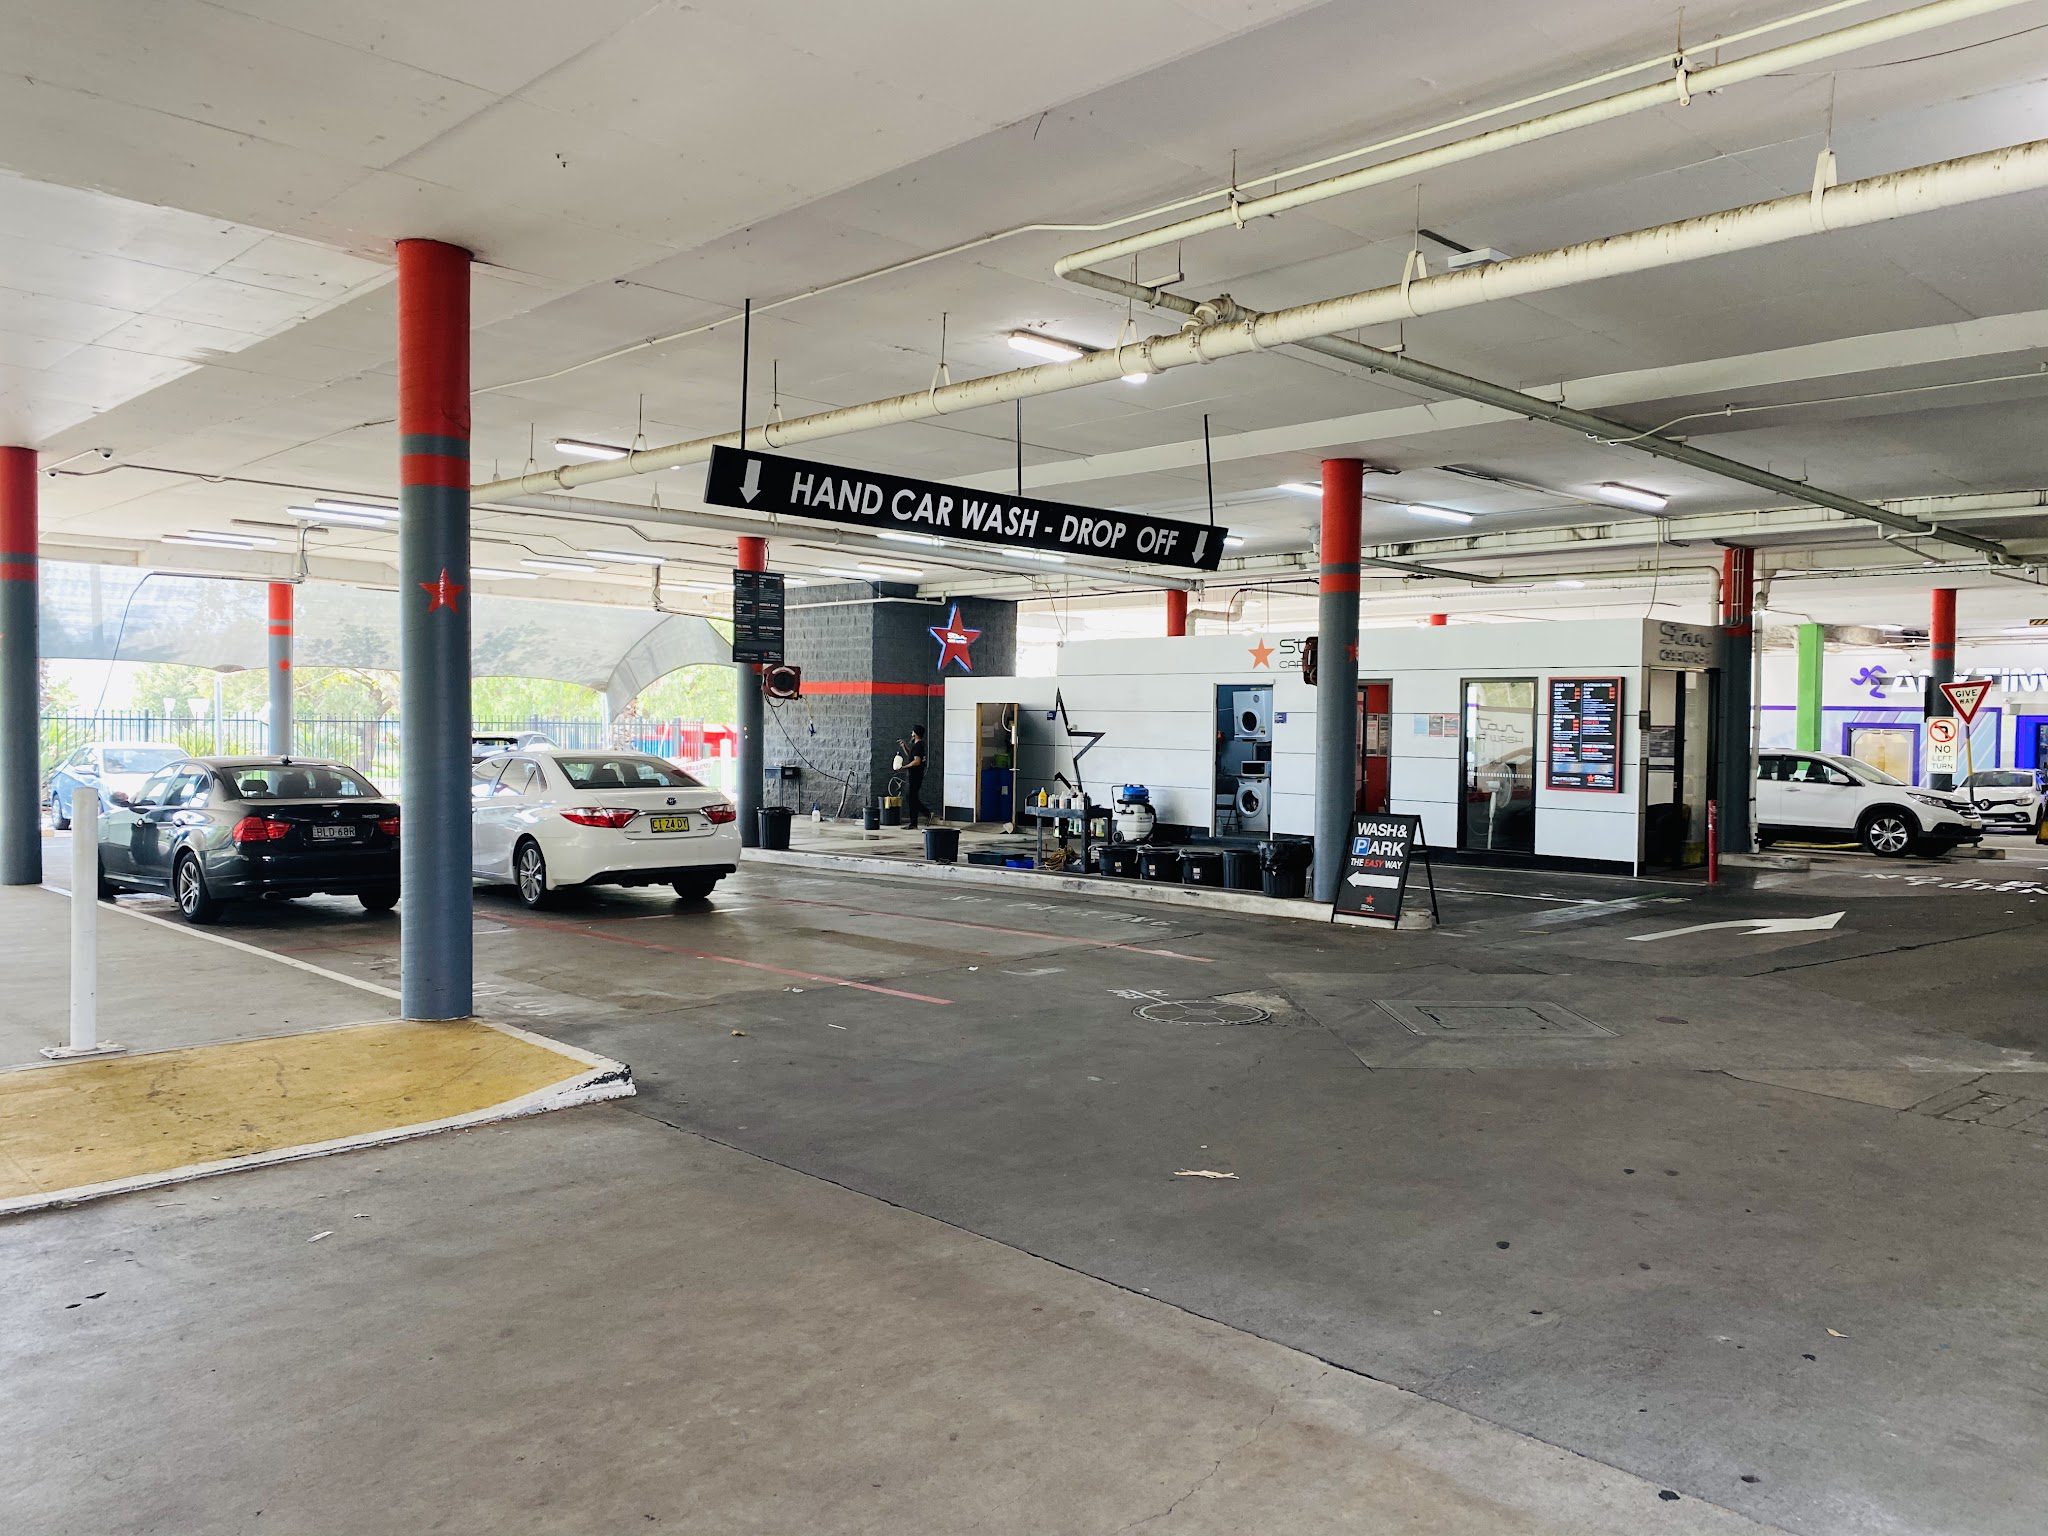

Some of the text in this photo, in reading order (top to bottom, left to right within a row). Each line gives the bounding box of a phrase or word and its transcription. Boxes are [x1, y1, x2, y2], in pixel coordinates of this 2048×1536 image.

[790, 471, 883, 516] HAND
[891, 489, 953, 528] CAR
[961, 499, 1038, 538] WASH
[1059, 515, 1127, 550] DROP
[1136, 526, 1180, 557] OFF
[1956, 688, 1978, 698] GIVE
[1934, 745, 1951, 754] NO
[1352, 837, 1406, 857] PARK
[1350, 857, 1403, 870] THE EASY WAY
